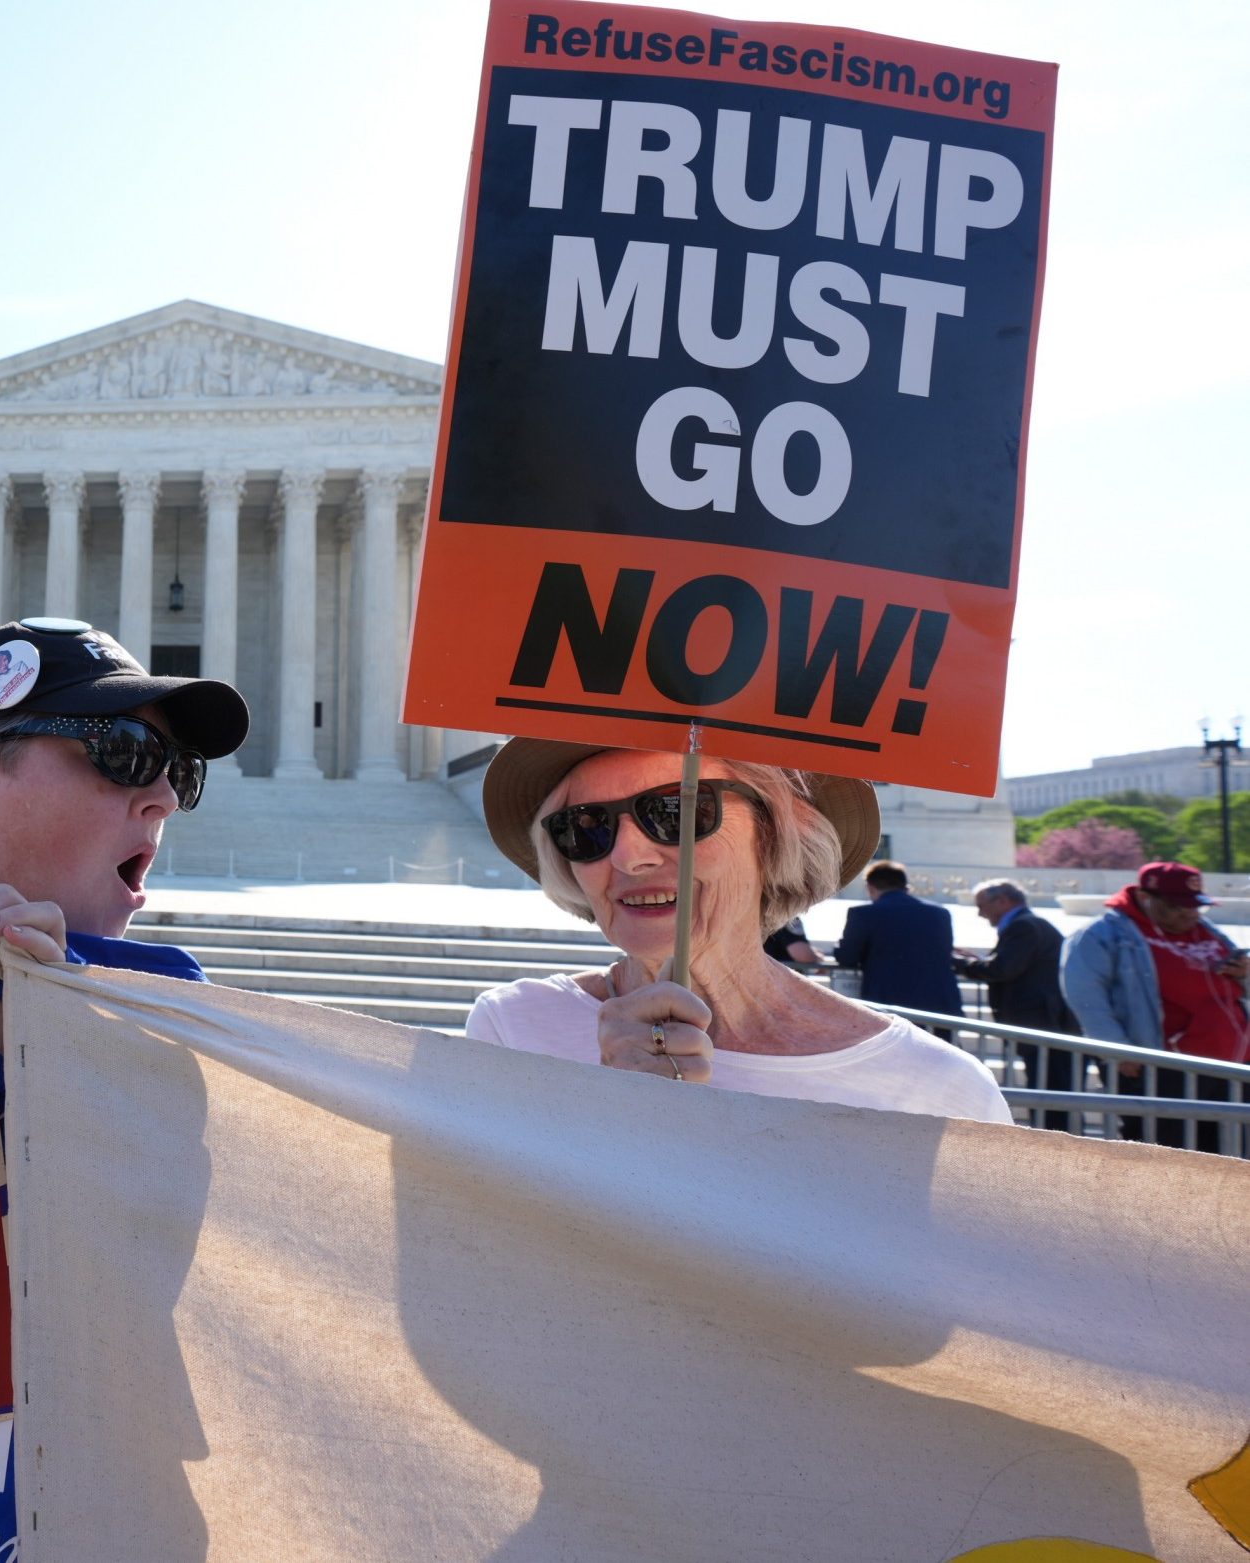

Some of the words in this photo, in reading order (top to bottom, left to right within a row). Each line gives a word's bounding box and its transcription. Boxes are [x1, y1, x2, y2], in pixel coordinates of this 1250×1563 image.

[524, 13, 1012, 118] RefuseFascism.org
[507, 94, 1025, 260] TRUMP
[541, 235, 966, 398] MUST
[635, 386, 853, 526] GO
[508, 561, 950, 737] NOW!
